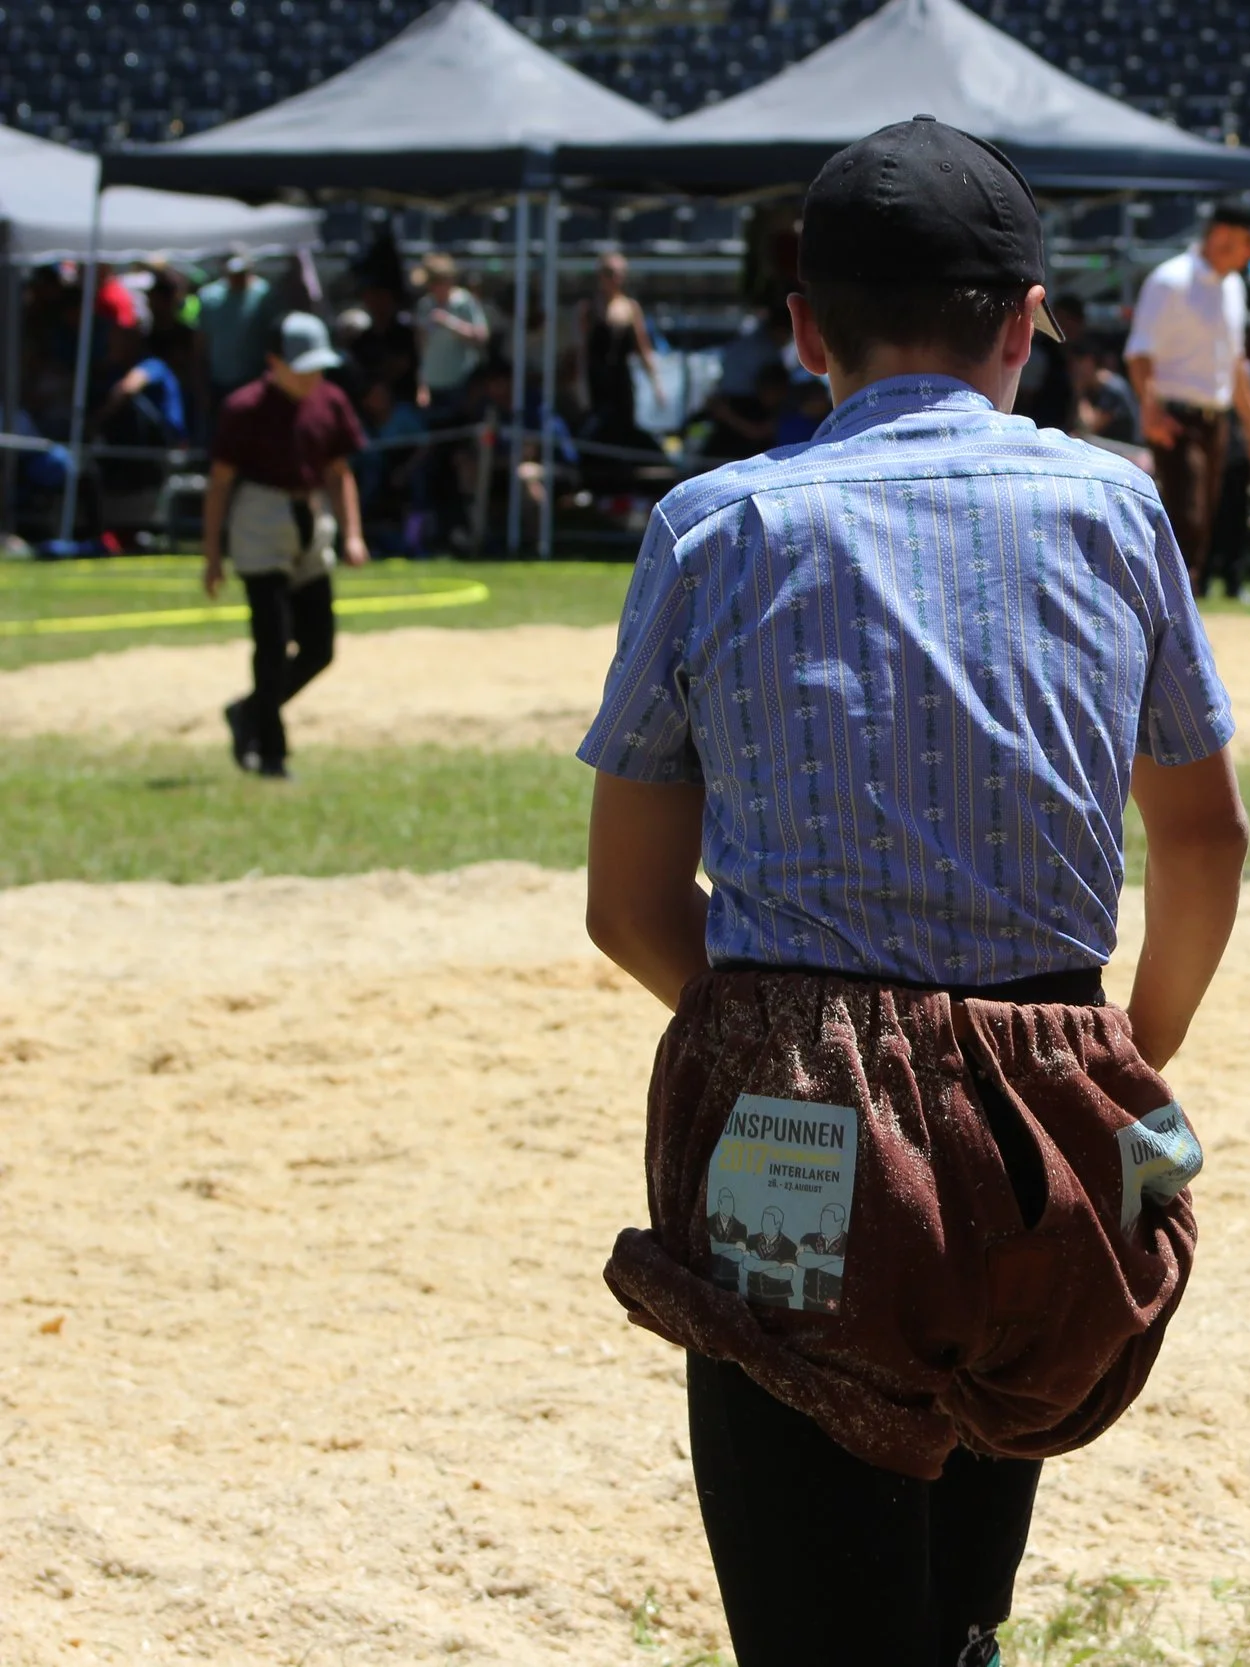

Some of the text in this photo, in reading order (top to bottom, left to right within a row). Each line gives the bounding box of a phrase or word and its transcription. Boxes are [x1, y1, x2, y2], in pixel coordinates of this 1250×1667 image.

[724, 1111, 844, 1149] UNSPUNNEN
[718, 1139, 769, 1174] 2017
[769, 1163, 840, 1183] INTERLAKEN
